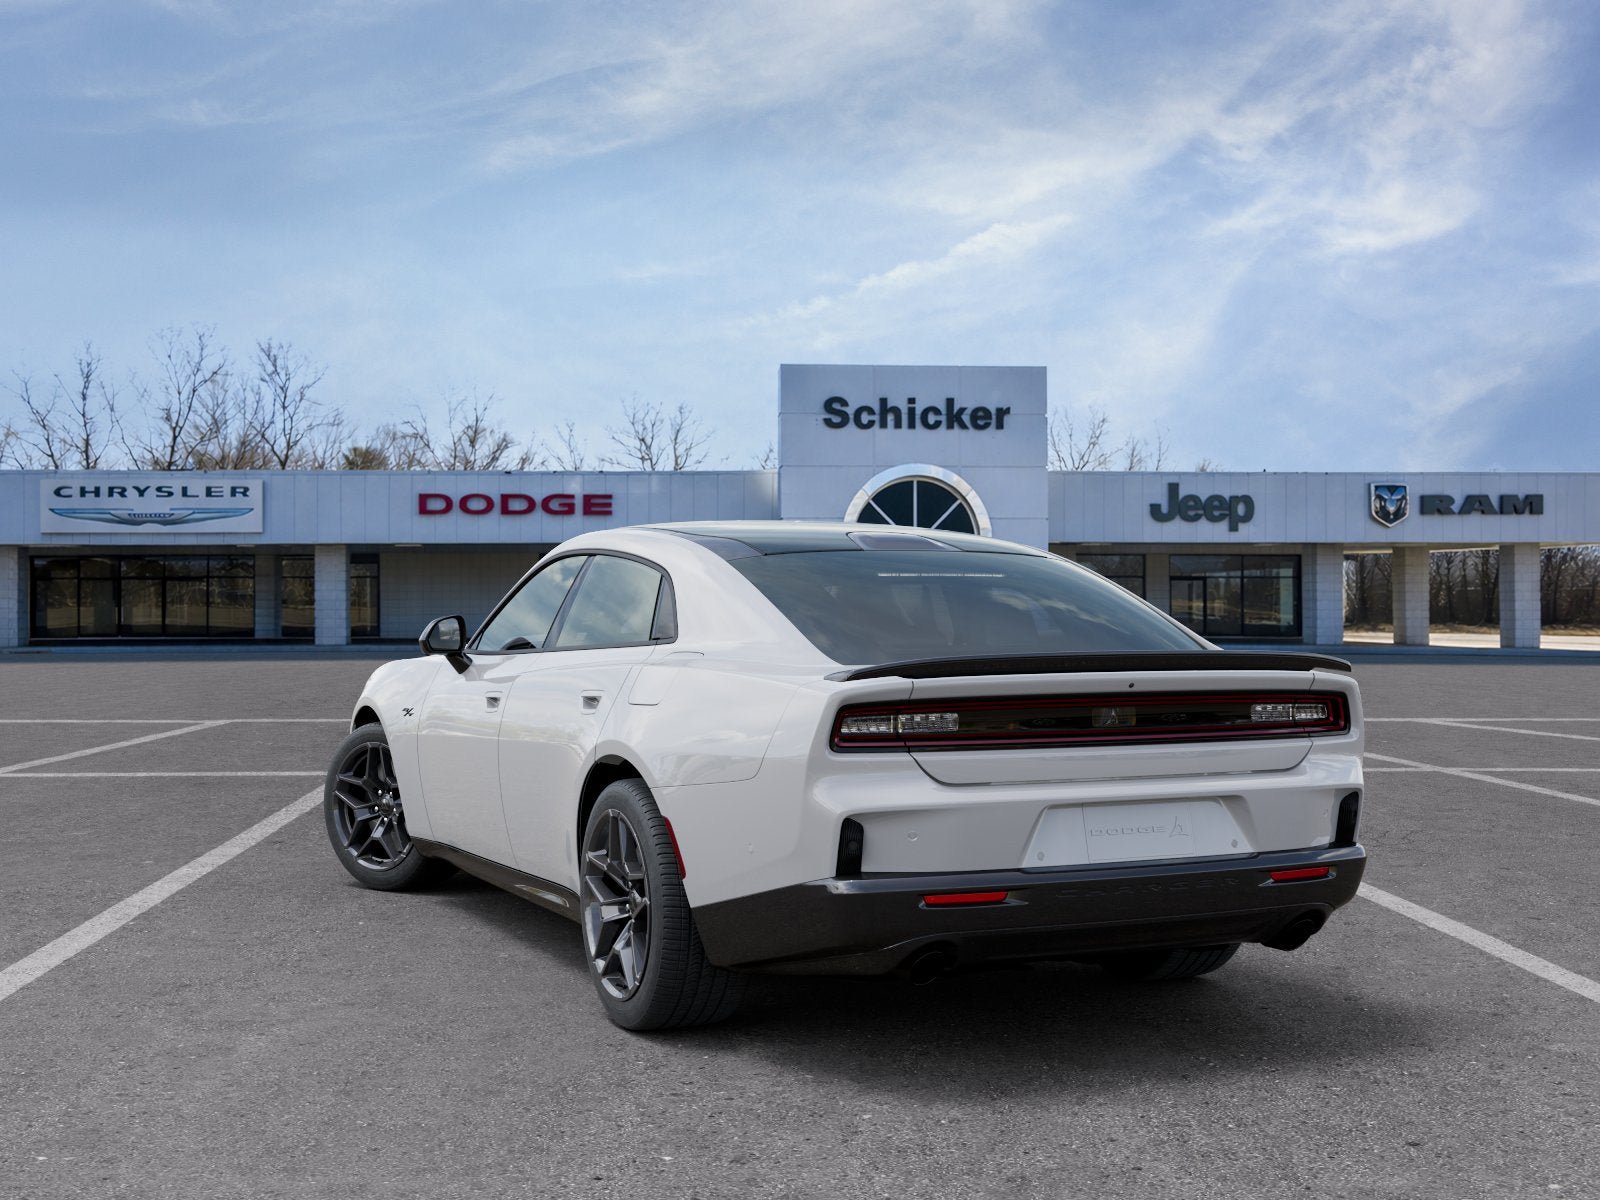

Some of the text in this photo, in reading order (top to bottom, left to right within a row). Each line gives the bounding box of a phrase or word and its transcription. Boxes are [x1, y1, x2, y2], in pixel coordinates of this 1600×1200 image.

[823, 396, 1011, 431] Schicker
[53, 485, 250, 499] CHRYSLER
[419, 494, 613, 516] DODGE
[1149, 482, 1255, 532] Jeep
[1420, 494, 1544, 516] RAM
[1089, 824, 1167, 838] DODGE
